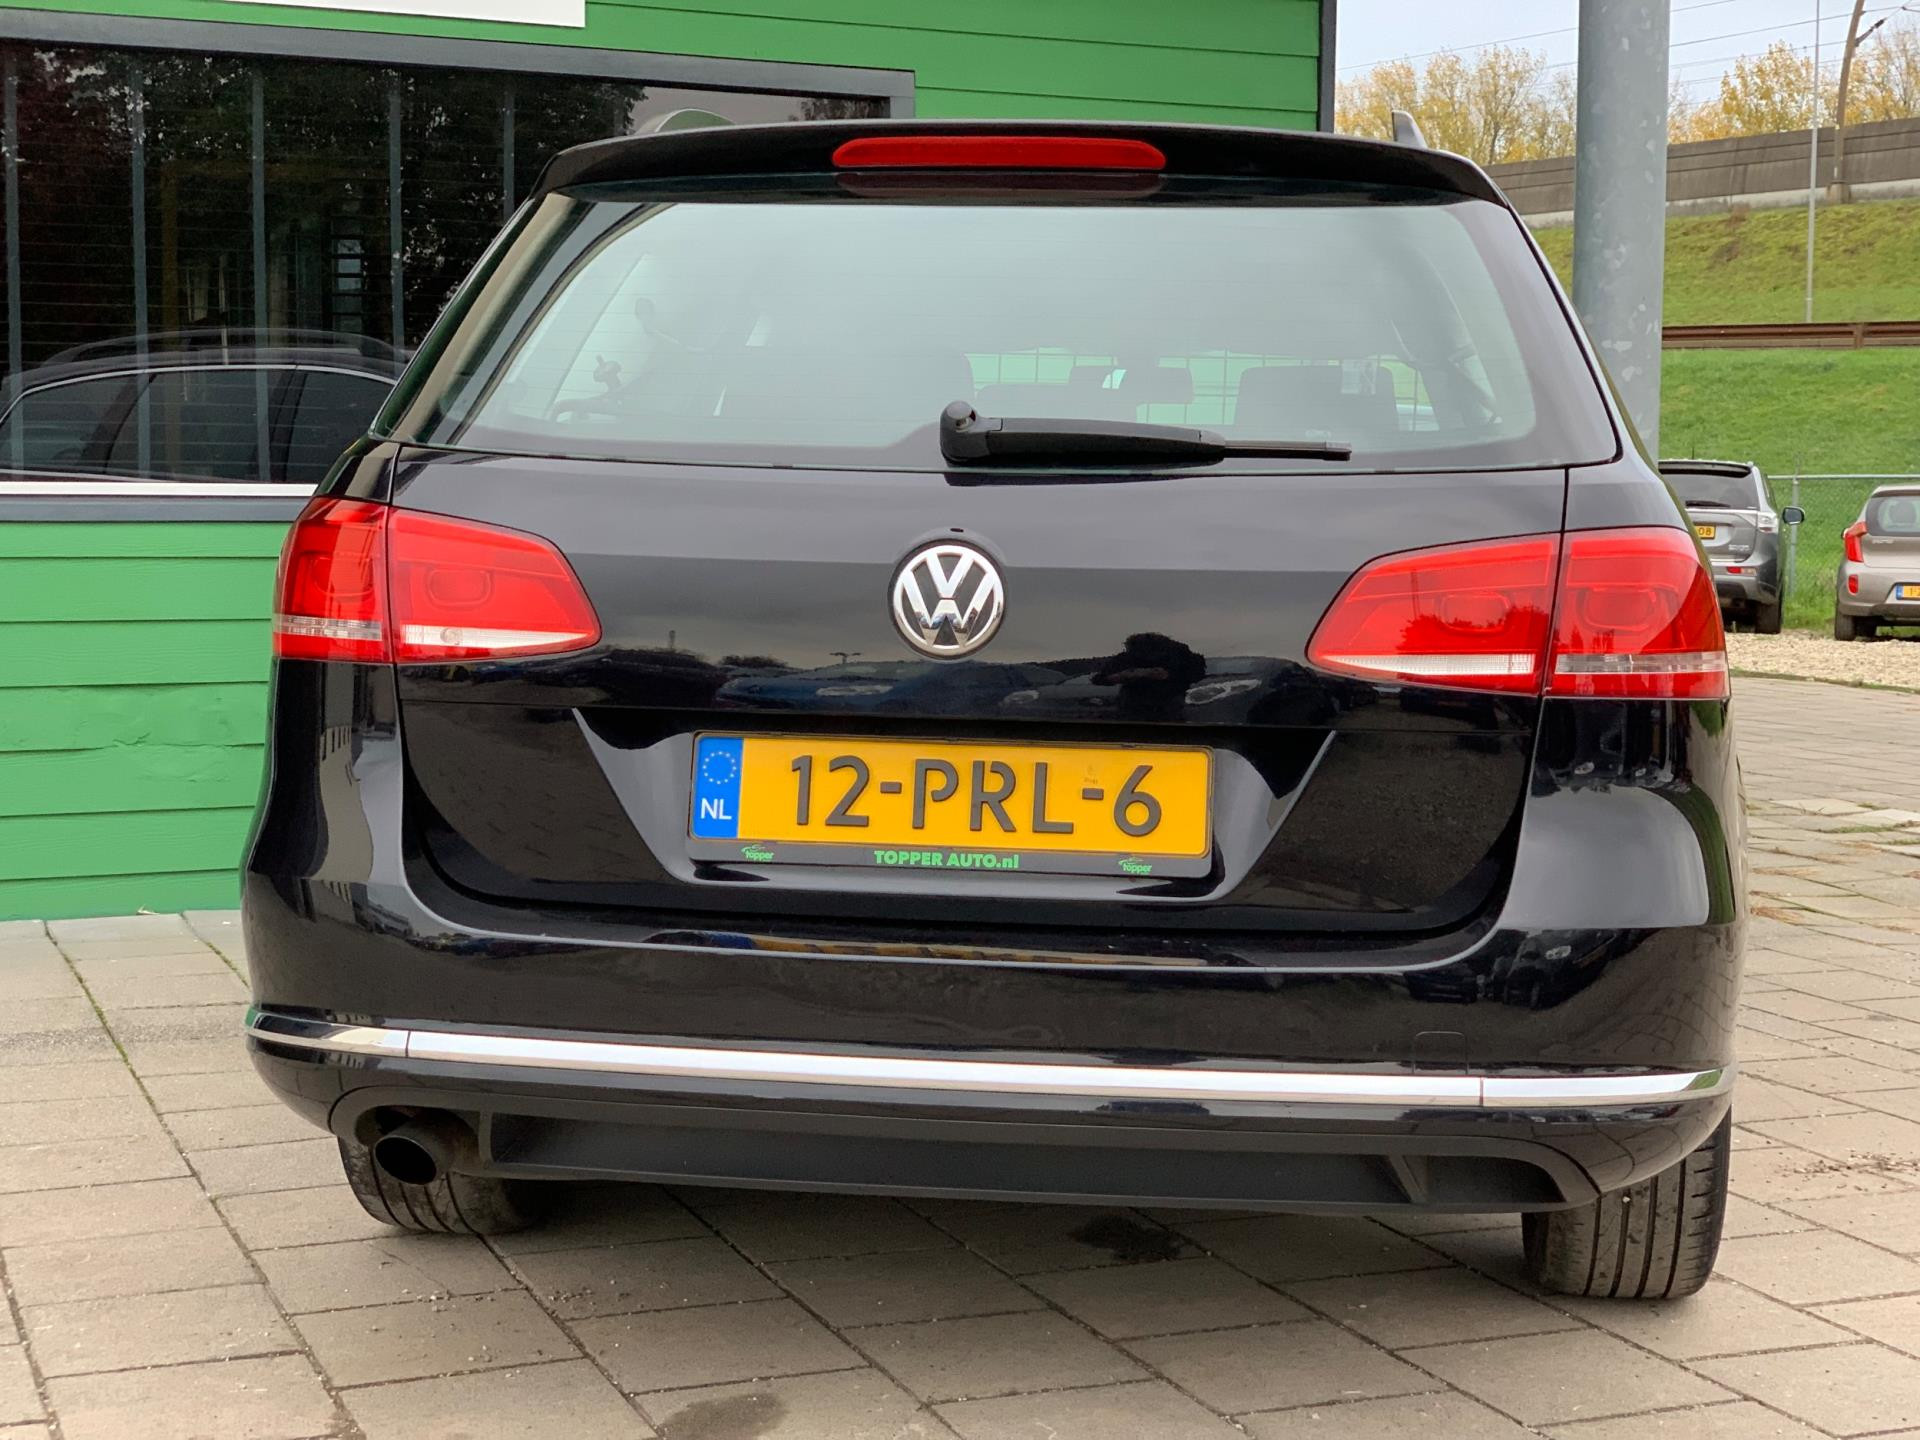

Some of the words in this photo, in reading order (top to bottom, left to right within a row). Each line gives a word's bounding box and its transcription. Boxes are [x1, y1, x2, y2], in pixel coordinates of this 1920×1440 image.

[791, 754, 1162, 838] 12-PRL-6
[701, 798, 732, 820] NL
[874, 850, 943, 866] TOPPER
[946, 853, 1020, 869] AUTO.nl
